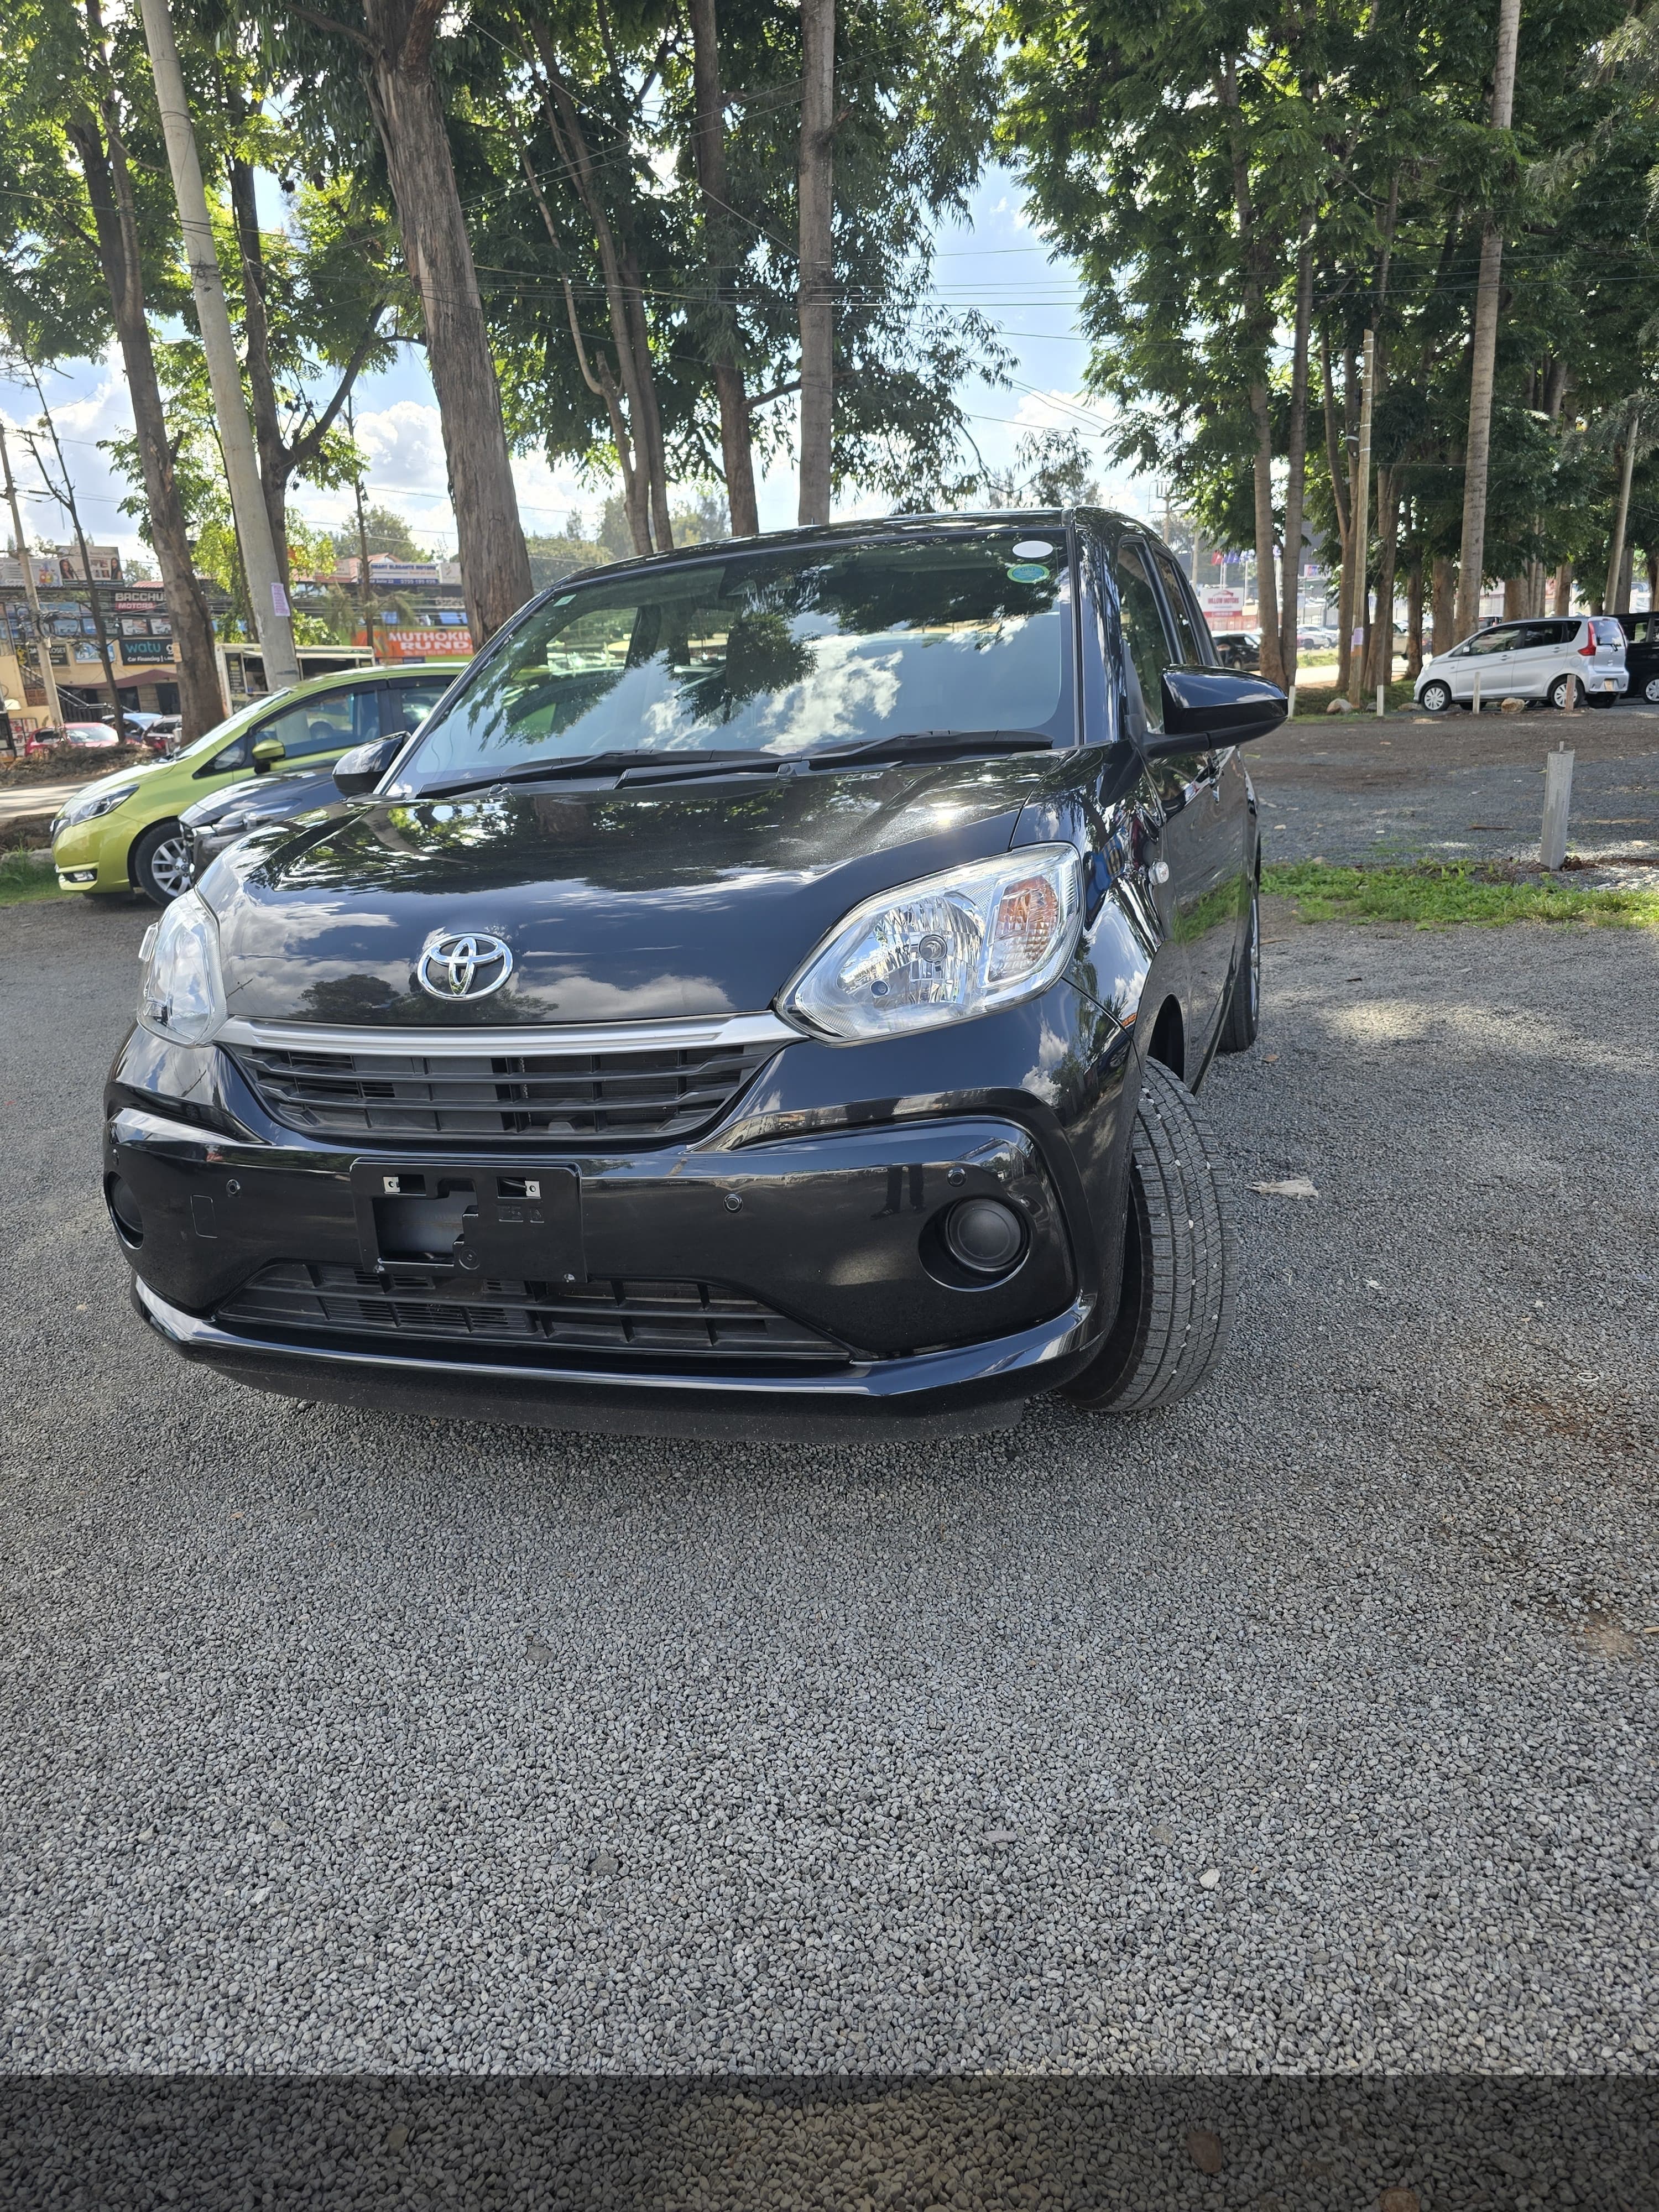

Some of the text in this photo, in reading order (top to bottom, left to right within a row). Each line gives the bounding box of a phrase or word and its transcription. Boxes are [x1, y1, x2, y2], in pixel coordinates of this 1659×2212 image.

[115, 593, 166, 602] BACCHU
[125, 641, 161, 653] watu
[400, 641, 473, 650] RUND
